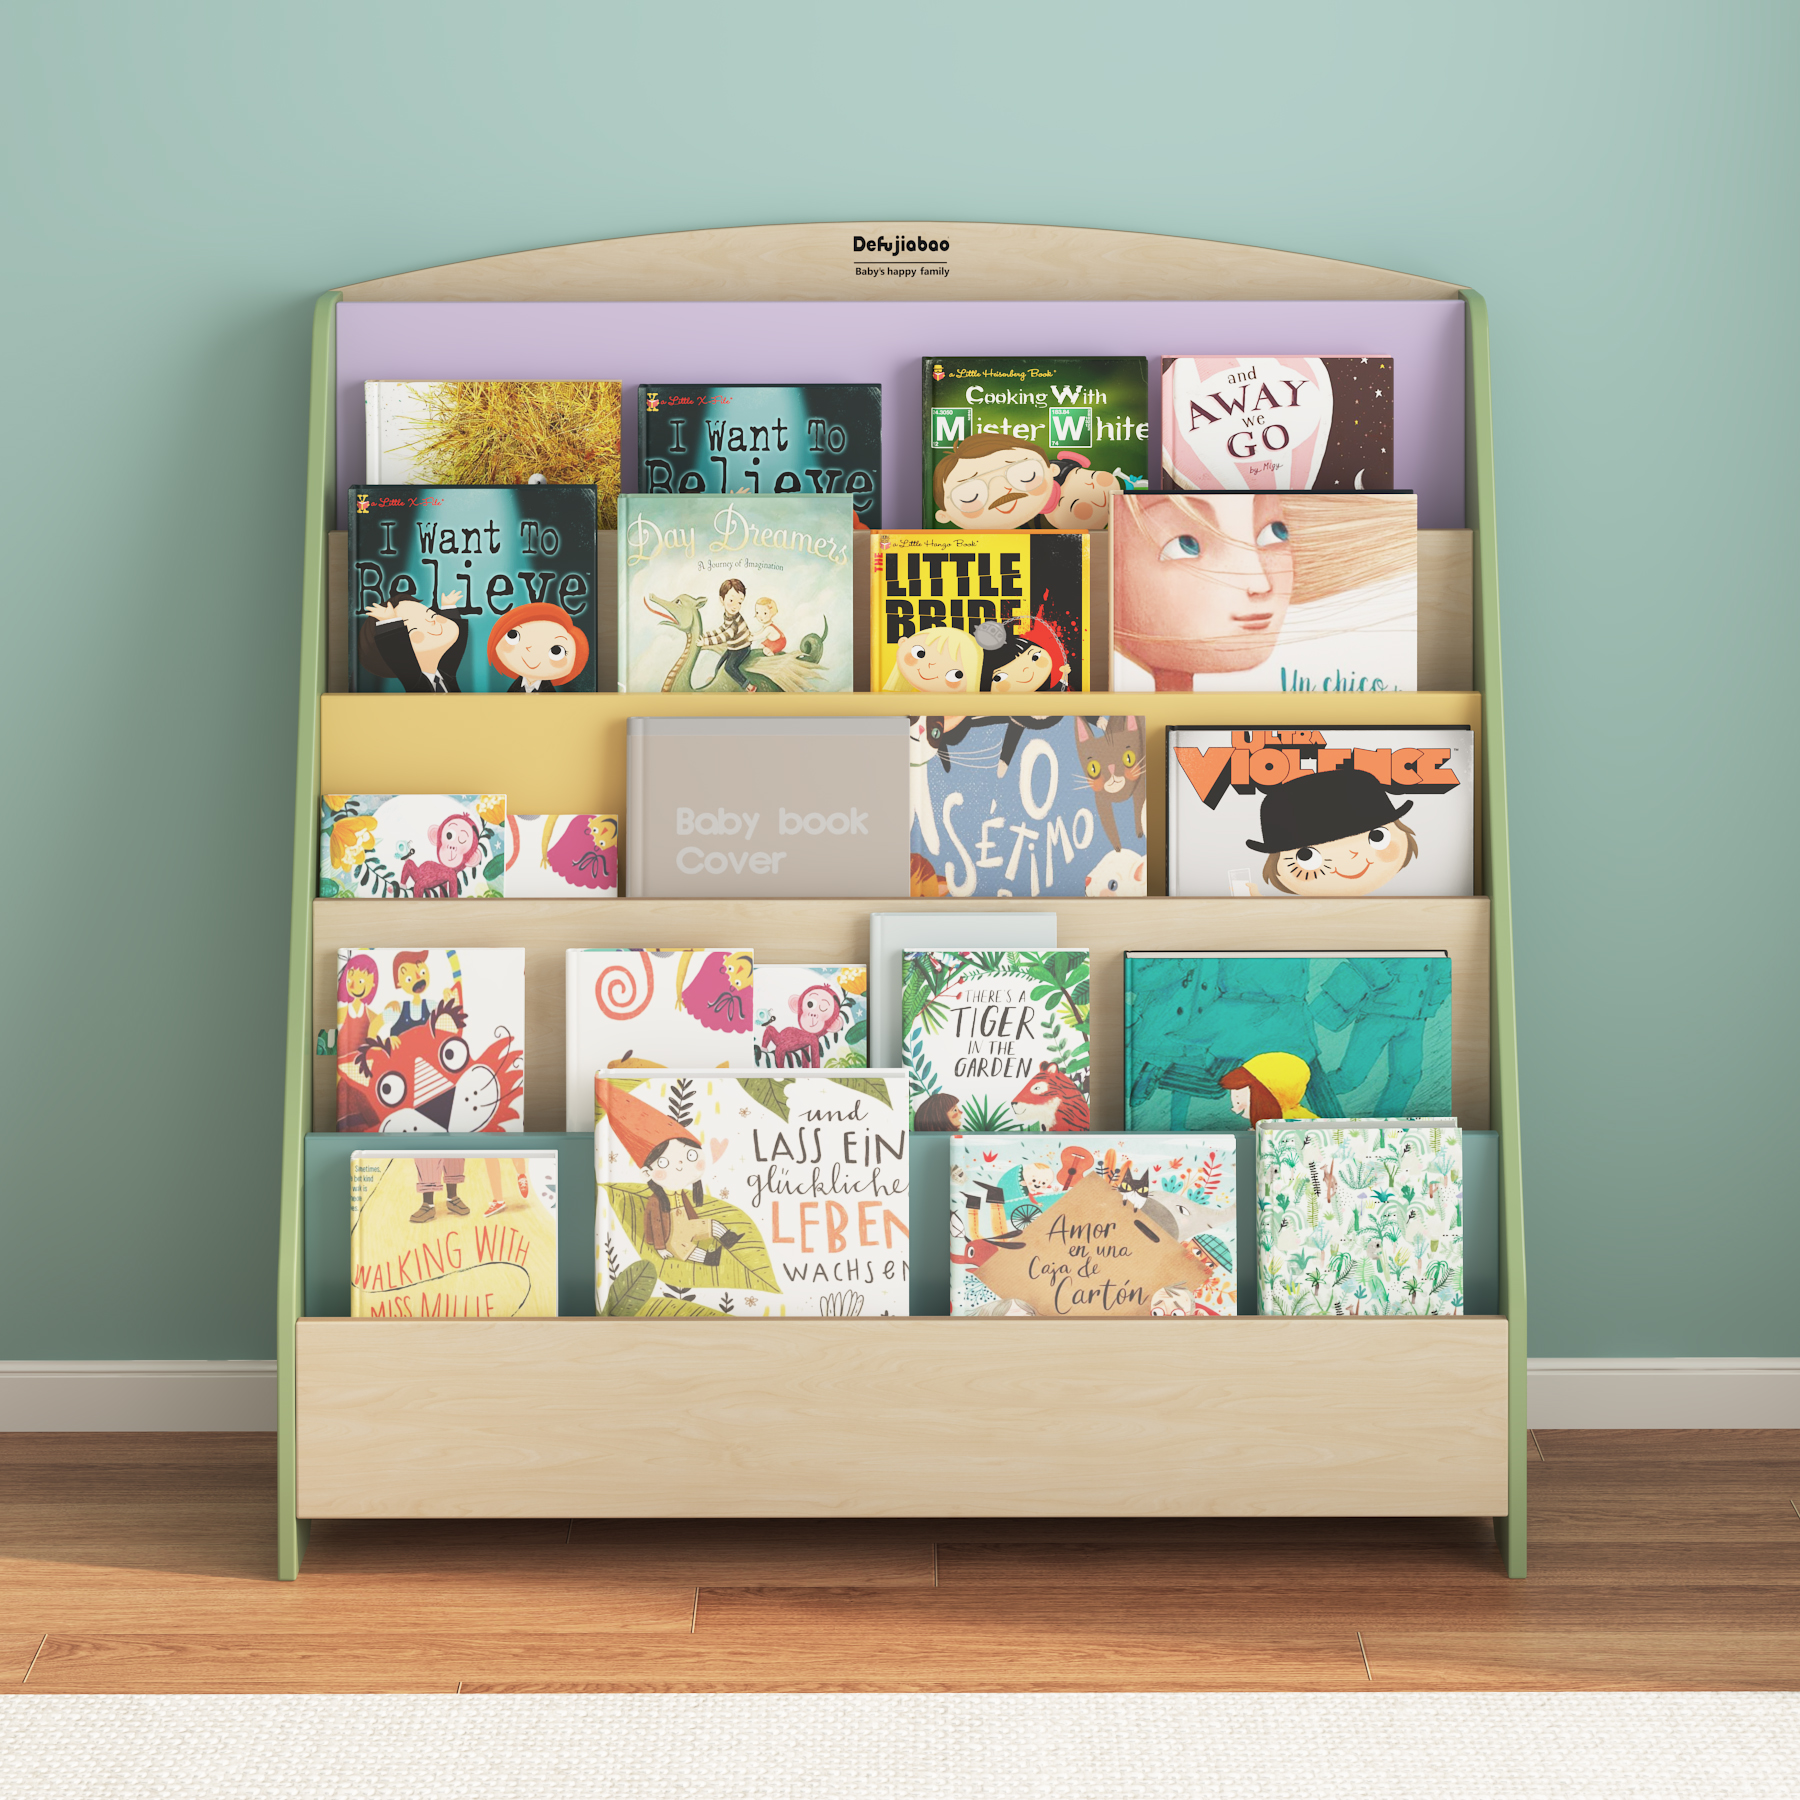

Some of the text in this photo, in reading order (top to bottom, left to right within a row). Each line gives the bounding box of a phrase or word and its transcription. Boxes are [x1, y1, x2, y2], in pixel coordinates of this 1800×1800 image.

[853, 235, 950, 256] Defujiabao
[855, 266, 950, 278] Baby's happy family
[956, 368, 982, 379] Little
[982, 368, 1027, 382] Heisenberg
[1027, 368, 1053, 378] Book
[1227, 366, 1258, 385] and
[667, 395, 695, 406] Little
[965, 385, 1107, 409] Cooking With
[1189, 379, 1309, 433] AWAY
[669, 417, 846, 453] I Want To
[1241, 413, 1266, 428] we
[1226, 423, 1290, 459] GO
[645, 456, 873, 512] Believe
[378, 497, 405, 508] Little
[380, 519, 559, 555] I Want To
[627, 502, 848, 566] Day Dreamers
[899, 539, 922, 548] Little
[953, 539, 978, 548] Book
[706, 559, 734, 572] Journey
[734, 558, 743, 568] of
[743, 557, 784, 571] Imagination
[874, 552, 883, 573] THE
[886, 553, 1022, 596] LITTLE
[355, 559, 587, 616] Believe
[886, 599, 1022, 644] BRIDE
[1281, 667, 1317, 691] Un
[1231, 731, 1327, 749] ULTRA
[1019, 738, 1059, 821] O
[1173, 747, 1461, 806] VIOLENCE
[676, 807, 869, 841] Baby book
[676, 846, 788, 875] Cover
[965, 988, 1026, 1004] THERE'S A
[950, 1005, 1035, 1041] TIGER
[967, 1040, 1016, 1056] IN THE
[954, 1057, 1033, 1079] GARDEN
[798, 1099, 869, 1122] und
[752, 1126, 823, 1165] LASS
[771, 1200, 909, 1254] LEBEN
[1045, 1213, 1117, 1246] Amor
[354, 1224, 531, 1290] WALKING WITH
[1069, 1244, 1133, 1259] en una
[1028, 1255, 1101, 1287] Caja de
[1054, 1275, 1150, 1315] Cartón
